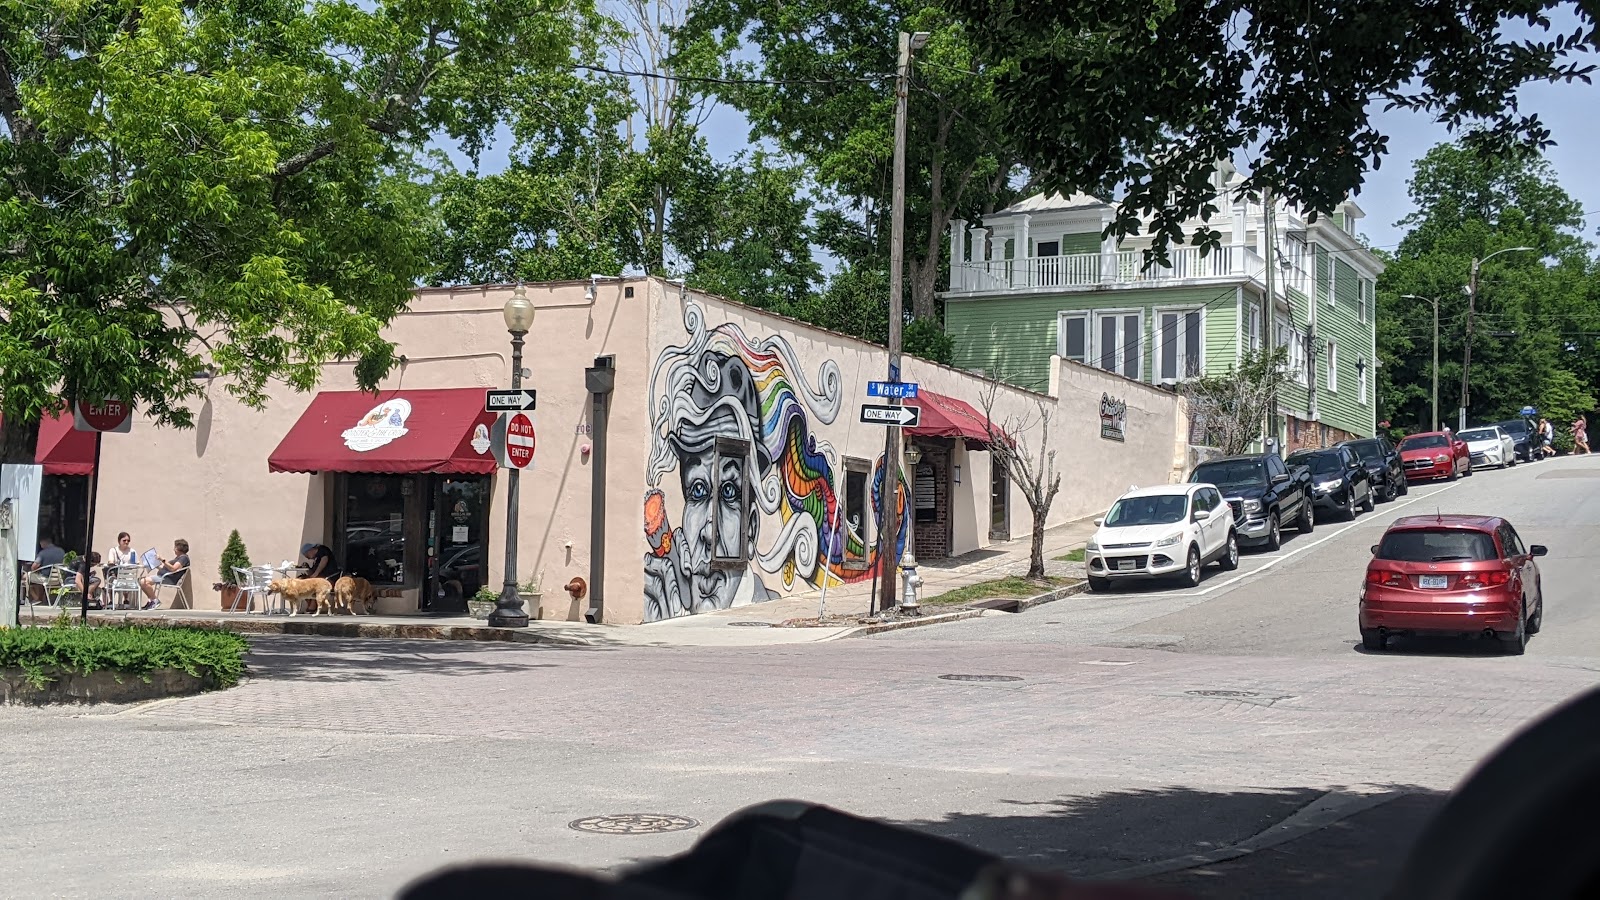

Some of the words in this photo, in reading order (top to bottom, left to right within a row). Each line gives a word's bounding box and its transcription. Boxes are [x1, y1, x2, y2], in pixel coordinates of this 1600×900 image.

[877, 383, 904, 396] Water
[491, 396, 505, 404] ONE
[507, 396, 521, 404] WAY
[89, 404, 121, 416] ENTER
[866, 410, 882, 418] ONE
[885, 411, 901, 419] WAY
[510, 423, 519, 432] DO
[521, 425, 531, 434] NOT
[511, 447, 529, 458] ENTER
